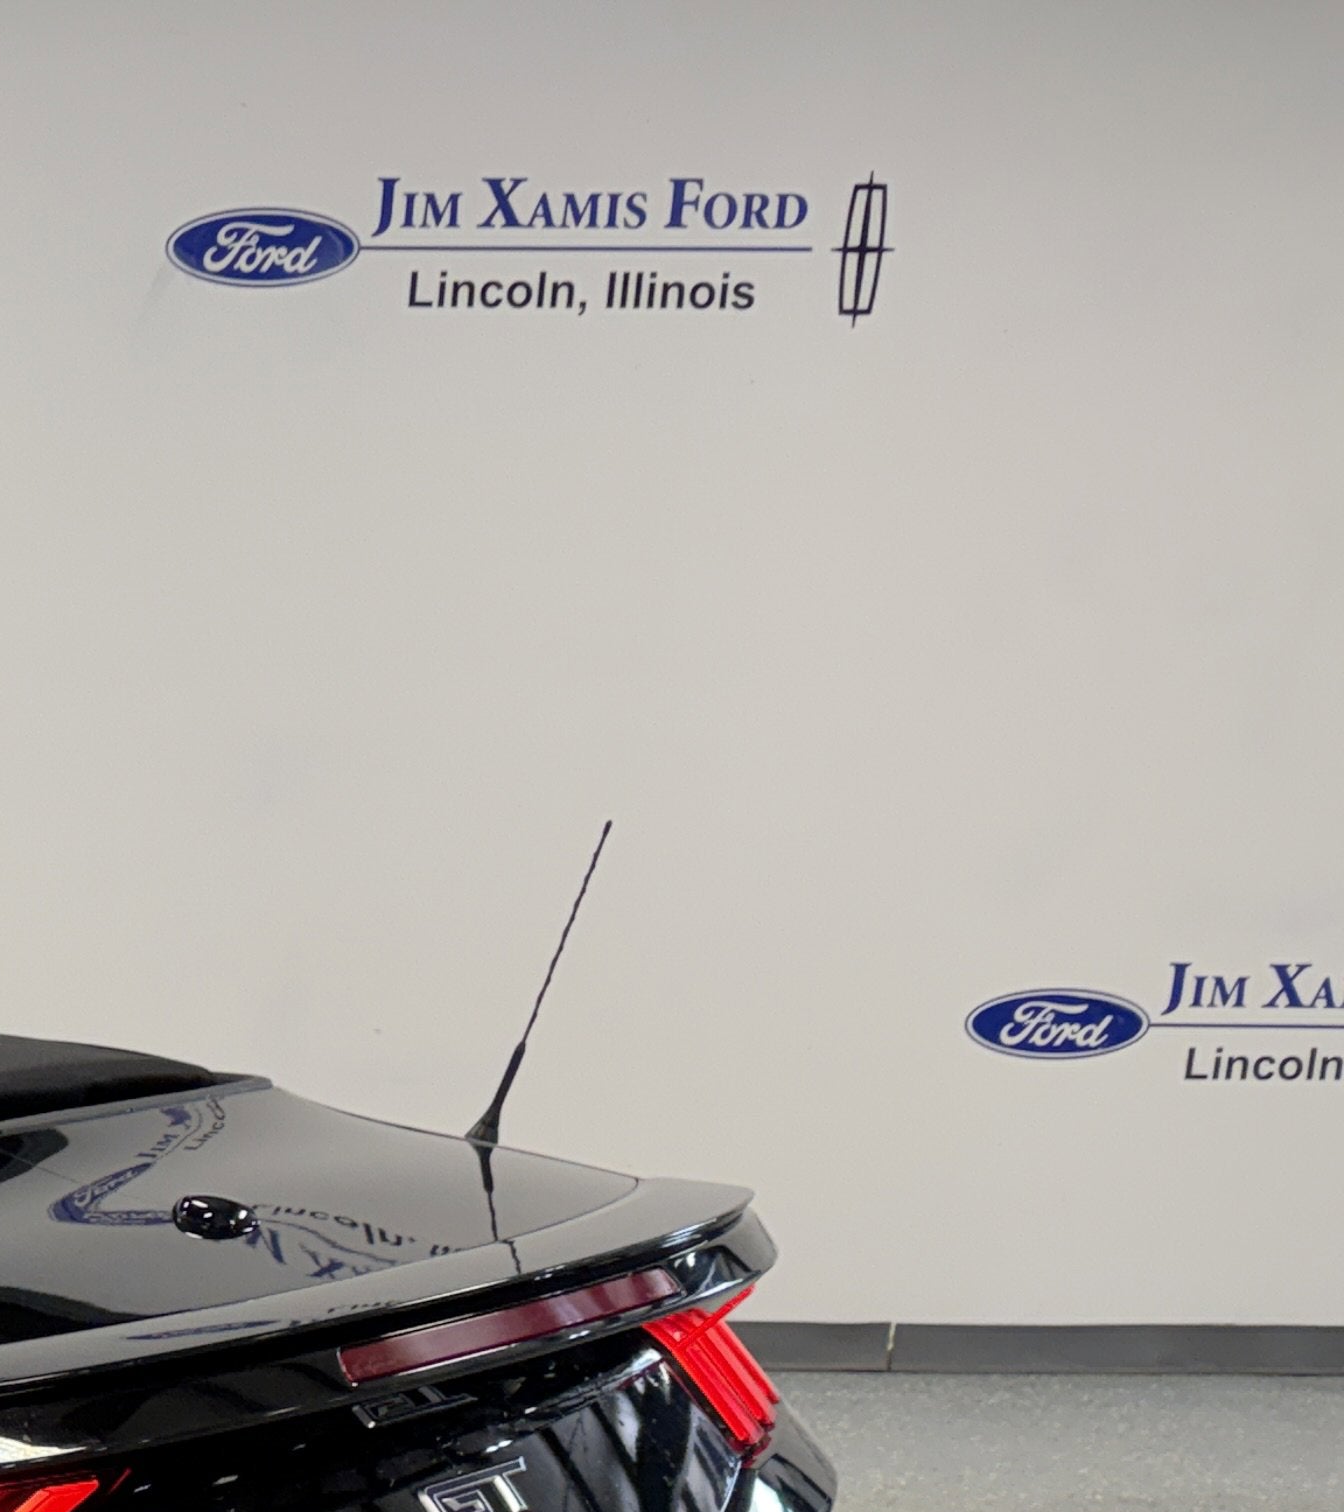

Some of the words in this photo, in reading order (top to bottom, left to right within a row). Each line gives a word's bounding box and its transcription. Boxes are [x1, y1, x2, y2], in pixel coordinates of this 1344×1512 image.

[370, 176, 463, 238] JIM
[476, 176, 648, 230] XAMIS
[663, 177, 809, 230] FORD
[202, 221, 323, 274] Ford
[407, 269, 588, 317] Lincoln,
[605, 270, 757, 311] Illinois
[1160, 961, 1250, 1017] JIM
[1260, 963, 1344, 1010] XA
[999, 1000, 1114, 1049] Ford
[1183, 1046, 1344, 1082] Lincoln
